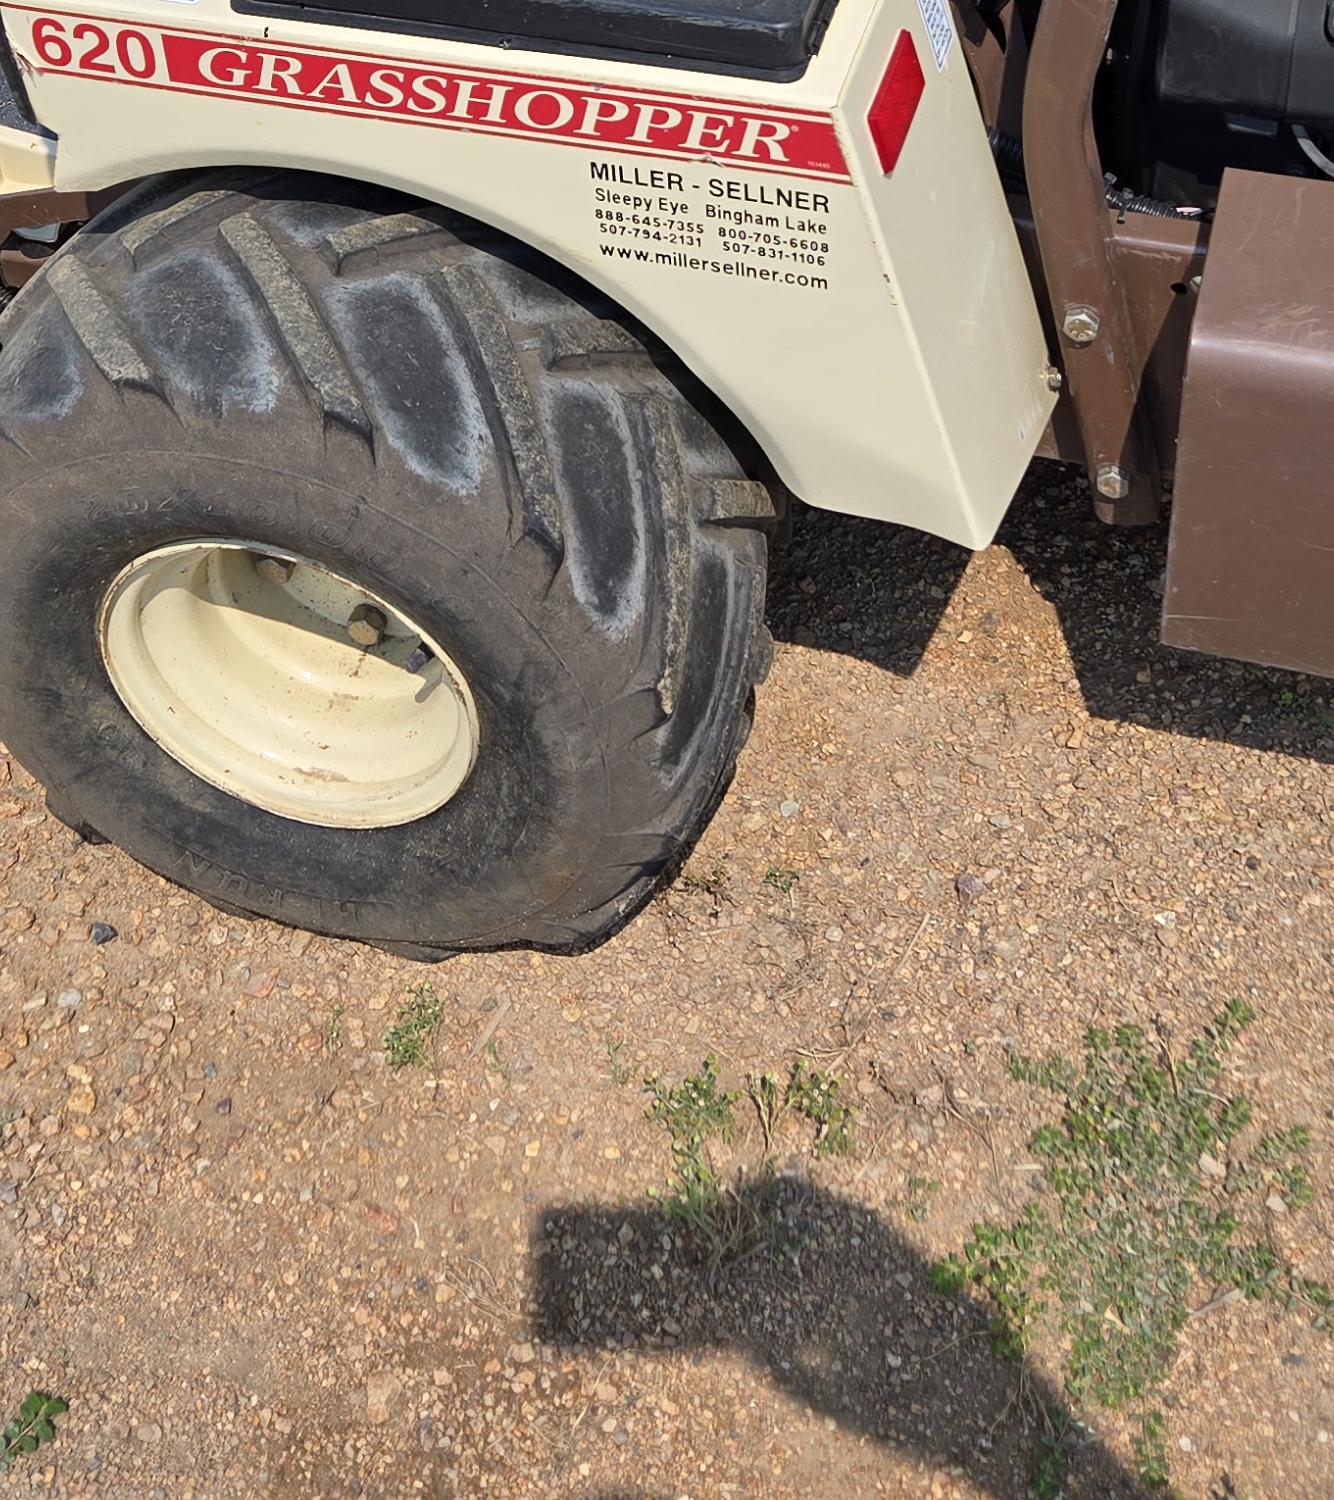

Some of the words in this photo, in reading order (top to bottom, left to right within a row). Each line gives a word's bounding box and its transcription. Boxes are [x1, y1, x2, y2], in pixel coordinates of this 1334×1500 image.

[30, 16, 156, 79] 620
[196, 46, 792, 161] GRASSHOPPER
[590, 161, 684, 192] MILLER
[708, 178, 830, 213] SELLNER
[594, 188, 653, 211] Sleepy
[658, 198, 689, 215] Eye
[705, 204, 780, 227] Bingham
[785, 216, 828, 235] Lake
[595, 208, 705, 234] 888-645-7355
[718, 226, 830, 253] 800-705-6608
[599, 223, 702, 248] 507-794-2131
[722, 241, 826, 266] 507-831-1106
[599, 244, 828, 290] www.millersellner.com
